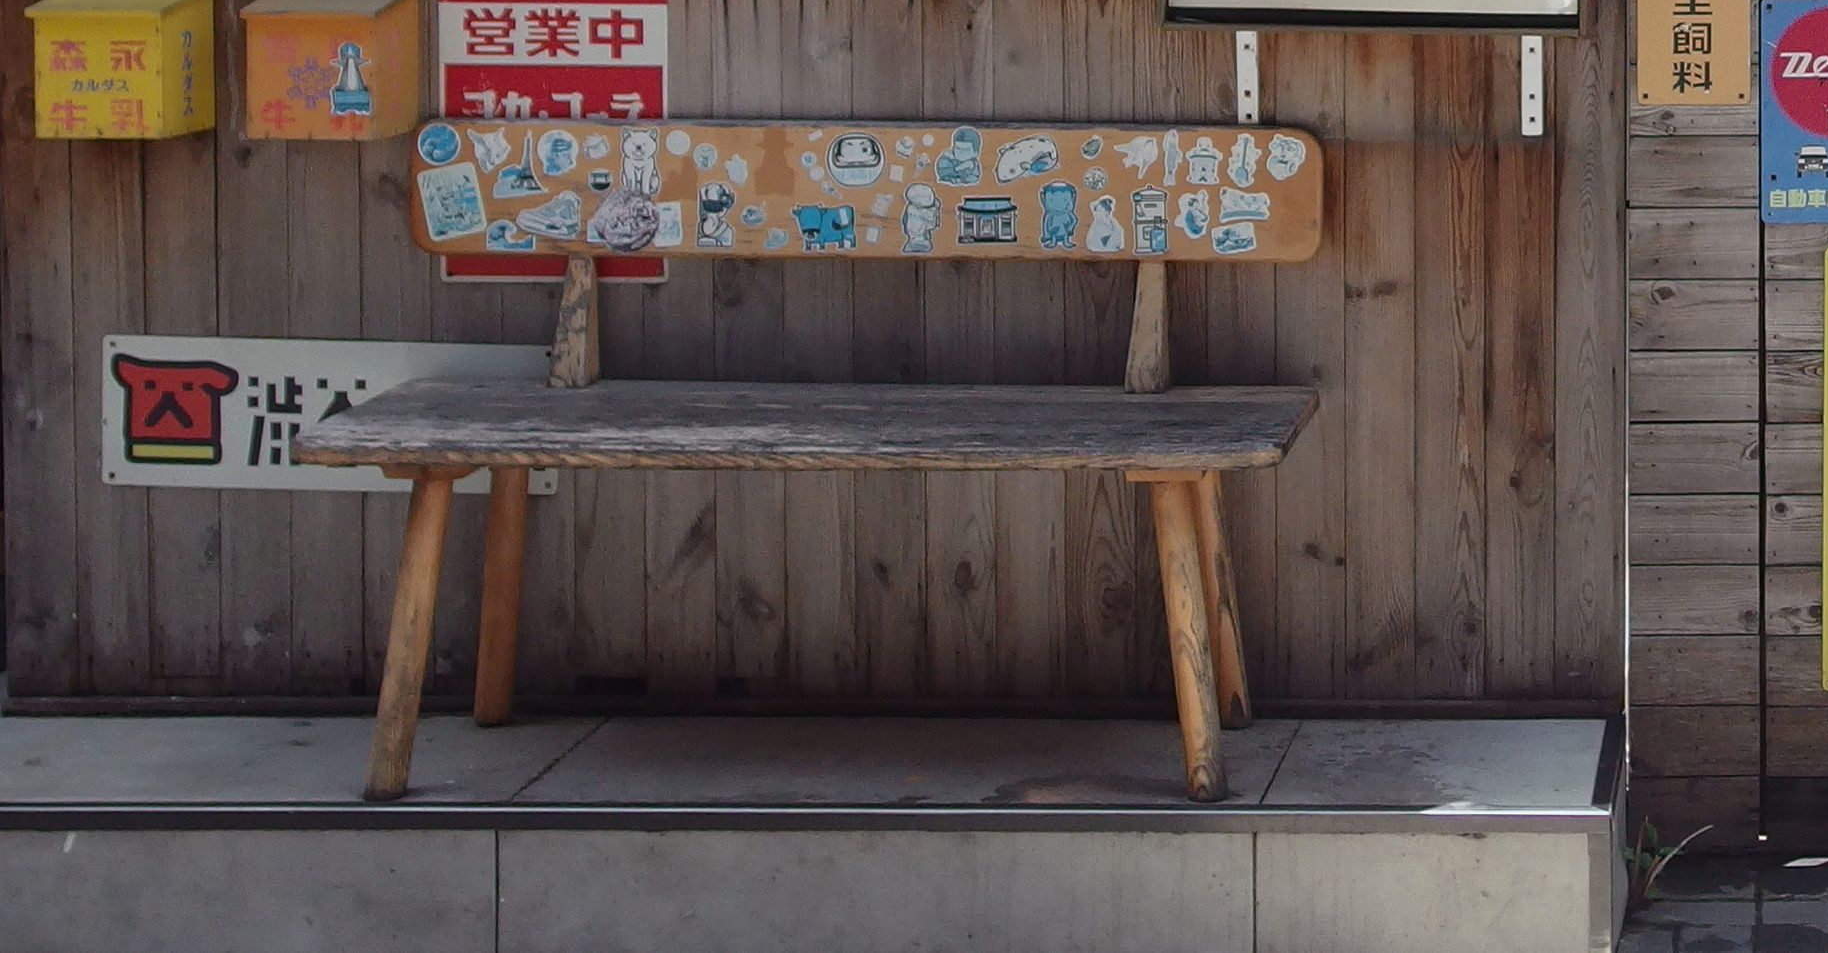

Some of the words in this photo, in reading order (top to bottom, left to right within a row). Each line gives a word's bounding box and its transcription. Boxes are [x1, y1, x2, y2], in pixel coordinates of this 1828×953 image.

[463, 7, 644, 59] 営業中
[49, 39, 147, 72] 森永
[49, 99, 148, 133] 牛乳
